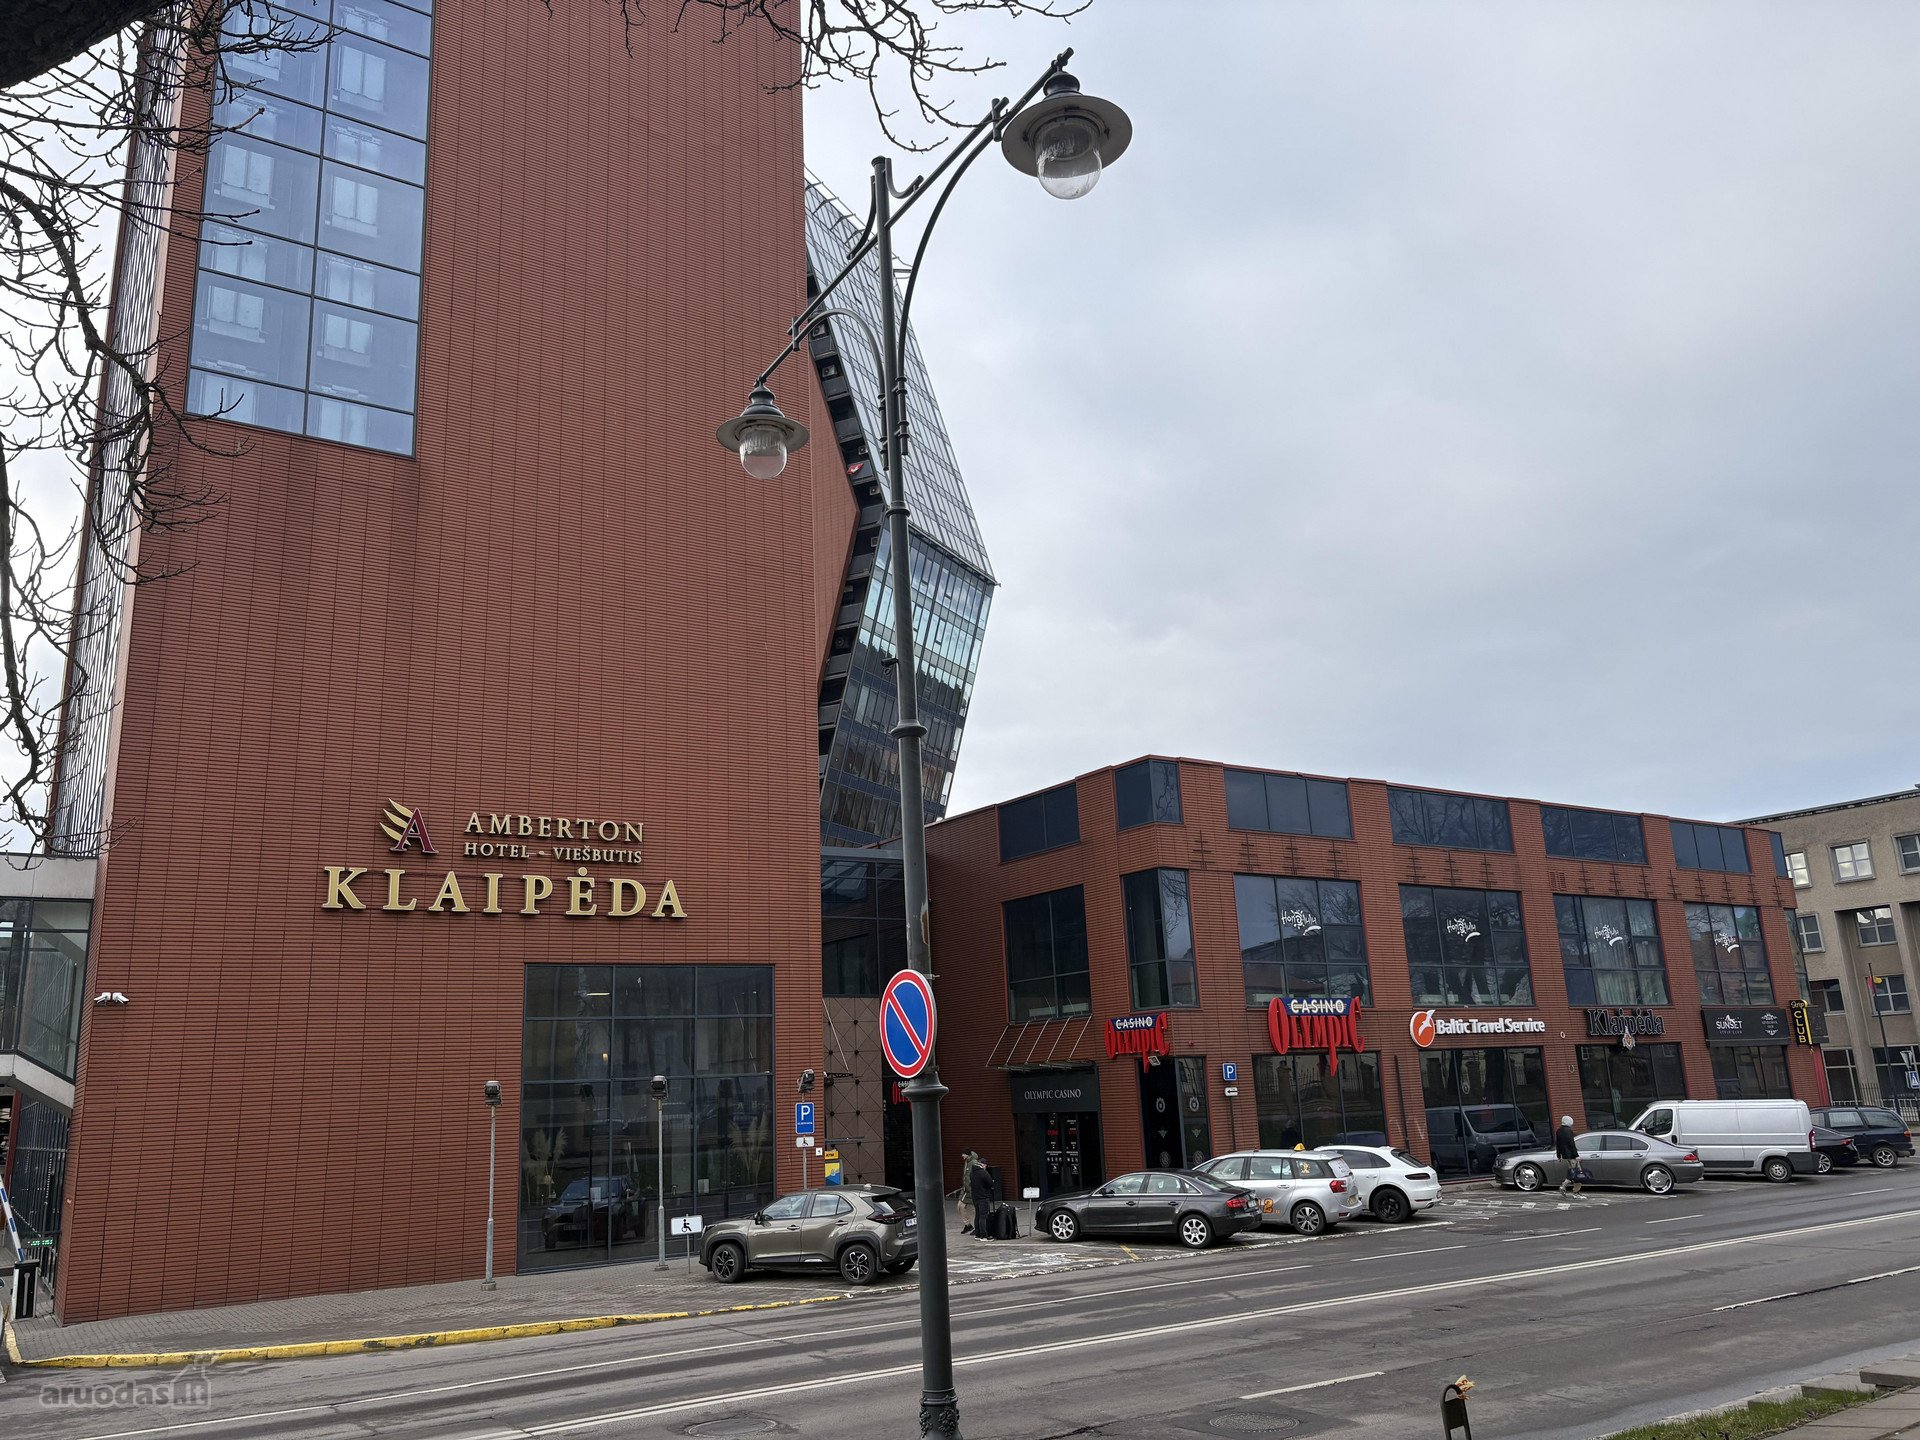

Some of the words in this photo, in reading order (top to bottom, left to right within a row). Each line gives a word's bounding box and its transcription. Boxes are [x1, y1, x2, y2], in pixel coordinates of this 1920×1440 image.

[464, 811, 644, 843] AMBERTON
[463, 842, 529, 859] HOTEL
[553, 845, 643, 865] VIEŠBUTIS
[322, 866, 688, 918] KLAIPĖDA
[1291, 999, 1345, 1014] CASINO
[1115, 1016, 1153, 1030] CASINO
[1436, 1018, 1470, 1035] Baltic
[1469, 1017, 1504, 1034] Travel
[1504, 1017, 1546, 1033] Service
[1587, 1007, 1667, 1036] Klaipėda
[1715, 1020, 1743, 1030] SUNSET
[1793, 1010, 1807, 1043] CLUB
[1104, 1011, 1170, 1073] OLYMPIC
[1268, 996, 1366, 1077] OLYMPIC
[1226, 1065, 1235, 1079] P
[1024, 1089, 1054, 1100] OLYMPIC
[1054, 1088, 1082, 1099] CASINO
[801, 1105, 811, 1121] P
